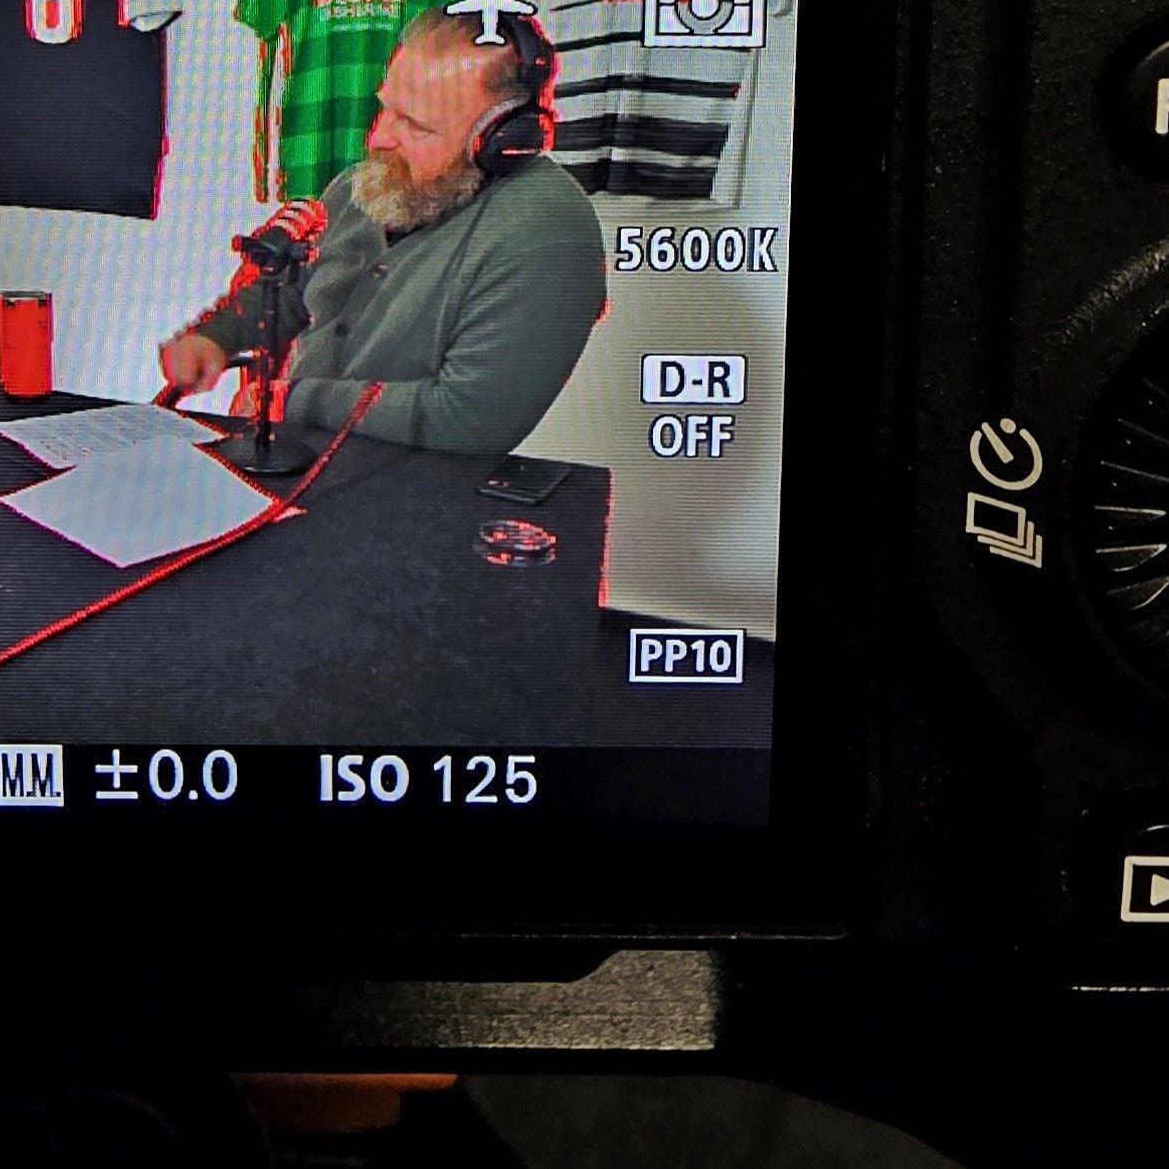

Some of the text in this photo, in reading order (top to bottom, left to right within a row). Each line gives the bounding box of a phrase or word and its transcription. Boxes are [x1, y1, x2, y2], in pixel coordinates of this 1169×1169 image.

[616, 228, 778, 270] 5600K
[659, 362, 731, 397] D-R
[652, 416, 734, 457] OFF
[639, 638, 732, 674] PP10
[320, 755, 538, 804] ISO 125
